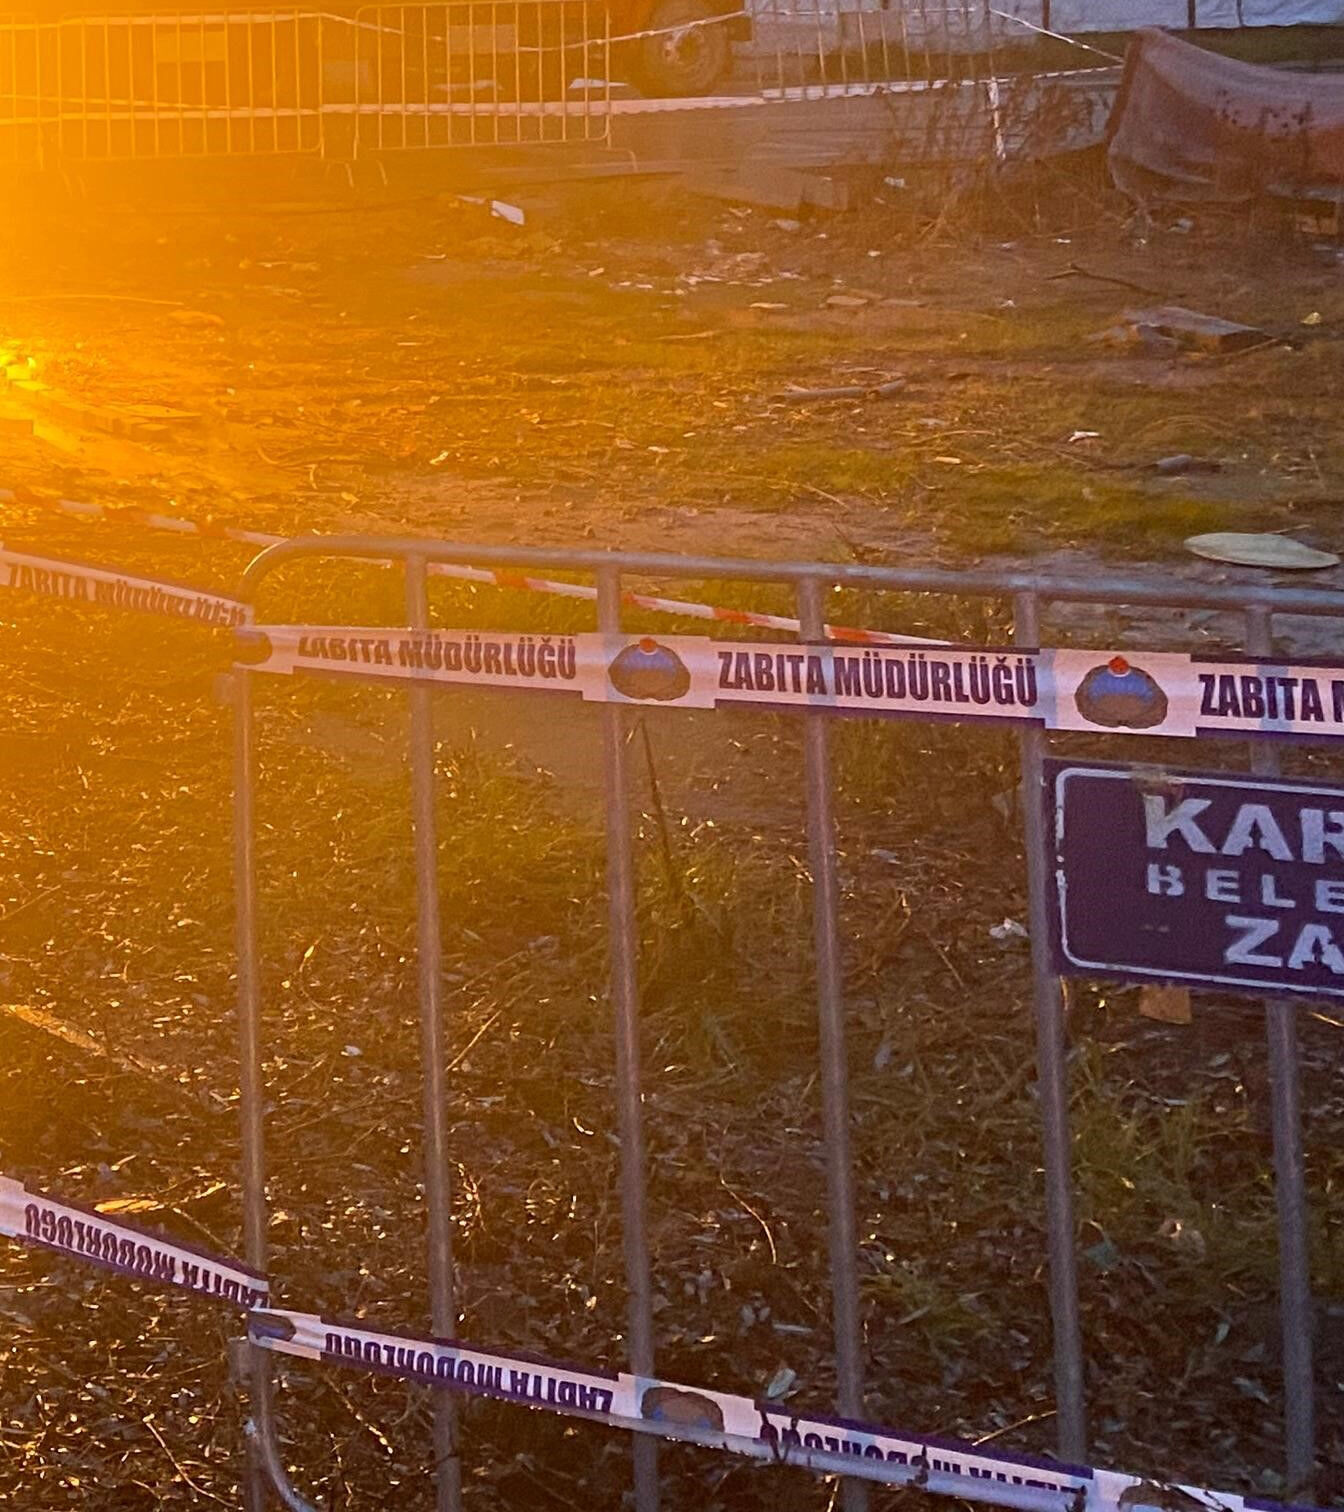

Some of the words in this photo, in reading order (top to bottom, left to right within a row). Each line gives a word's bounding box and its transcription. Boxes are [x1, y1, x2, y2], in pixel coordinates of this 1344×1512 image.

[298, 636, 393, 666] ZABITA
[396, 633, 577, 680] MÜDÜRLÜĞÜ
[717, 651, 828, 695] ZABITA
[833, 650, 1039, 707] MÜDÜRLÜĞÜ
[1199, 673, 1325, 722] ZABITA
[1142, 794, 1344, 864] KAR
[1147, 863, 1344, 914] BELE
[1225, 915, 1344, 975] ZA
